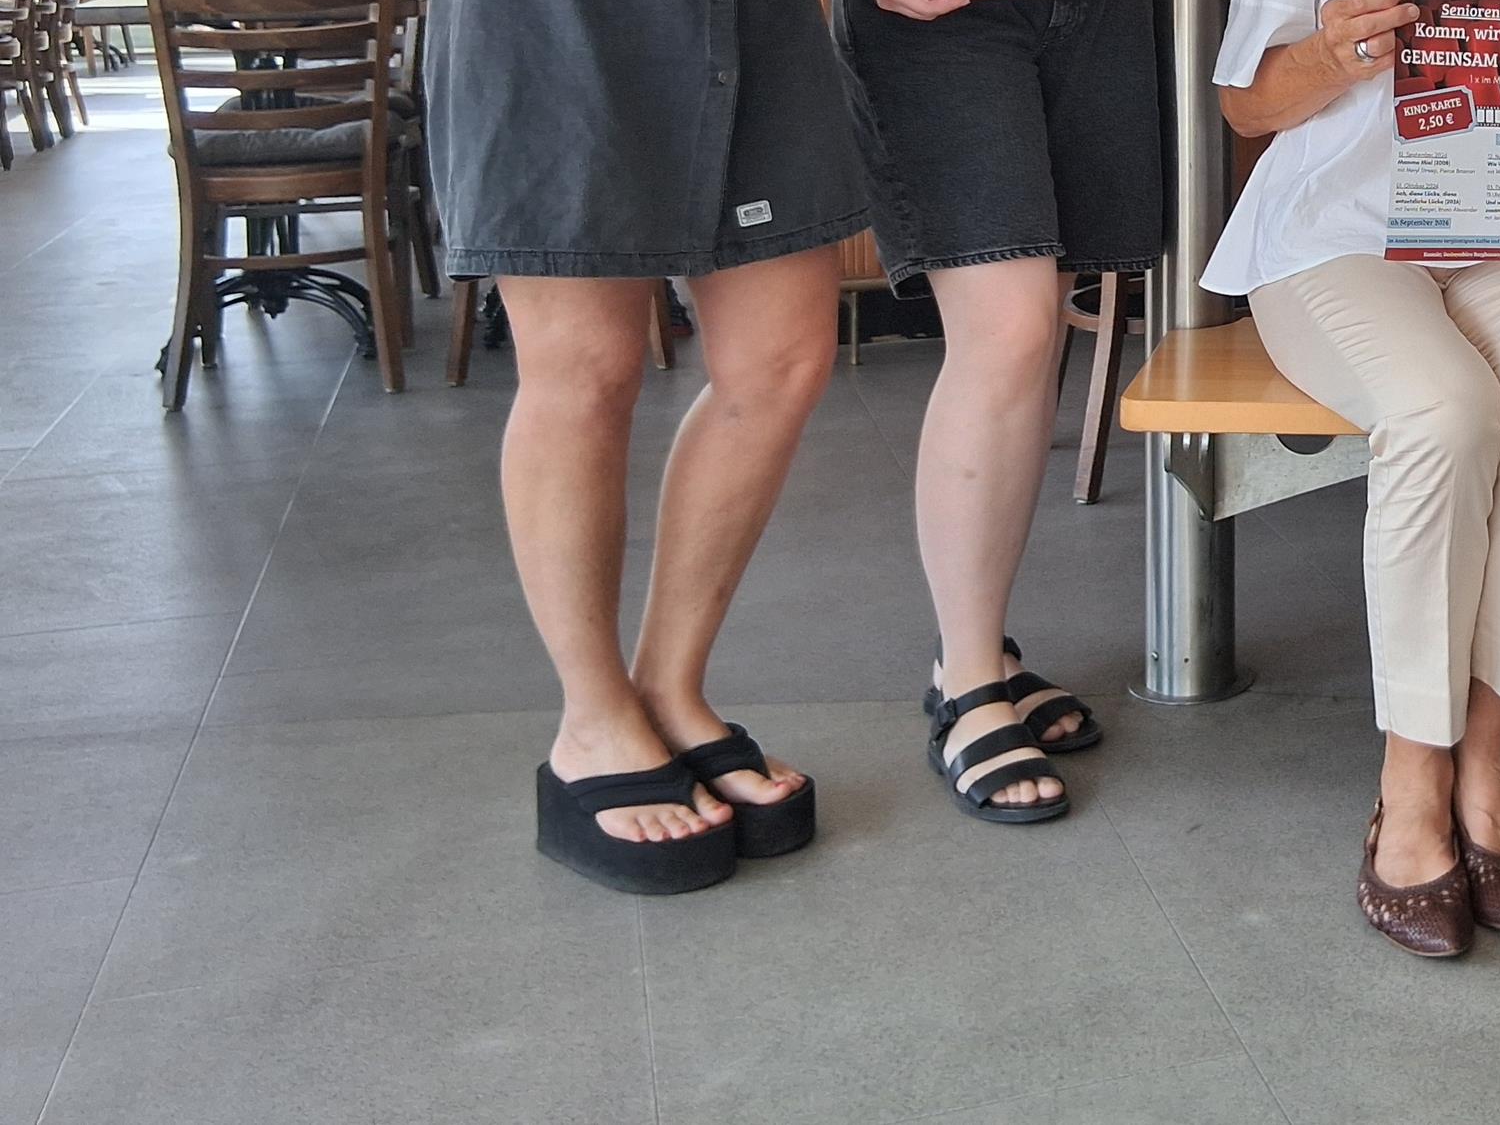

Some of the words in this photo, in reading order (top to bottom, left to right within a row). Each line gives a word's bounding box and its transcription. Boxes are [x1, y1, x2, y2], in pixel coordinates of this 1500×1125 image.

[1415, 23, 1470, 41] Komm,
[1401, 49, 1499, 67] GEMEINSAM
[1403, 97, 1462, 117] KINO-KARTE
[1419, 116, 1444, 131] 2,50
[1446, 113, 1455, 125] €
